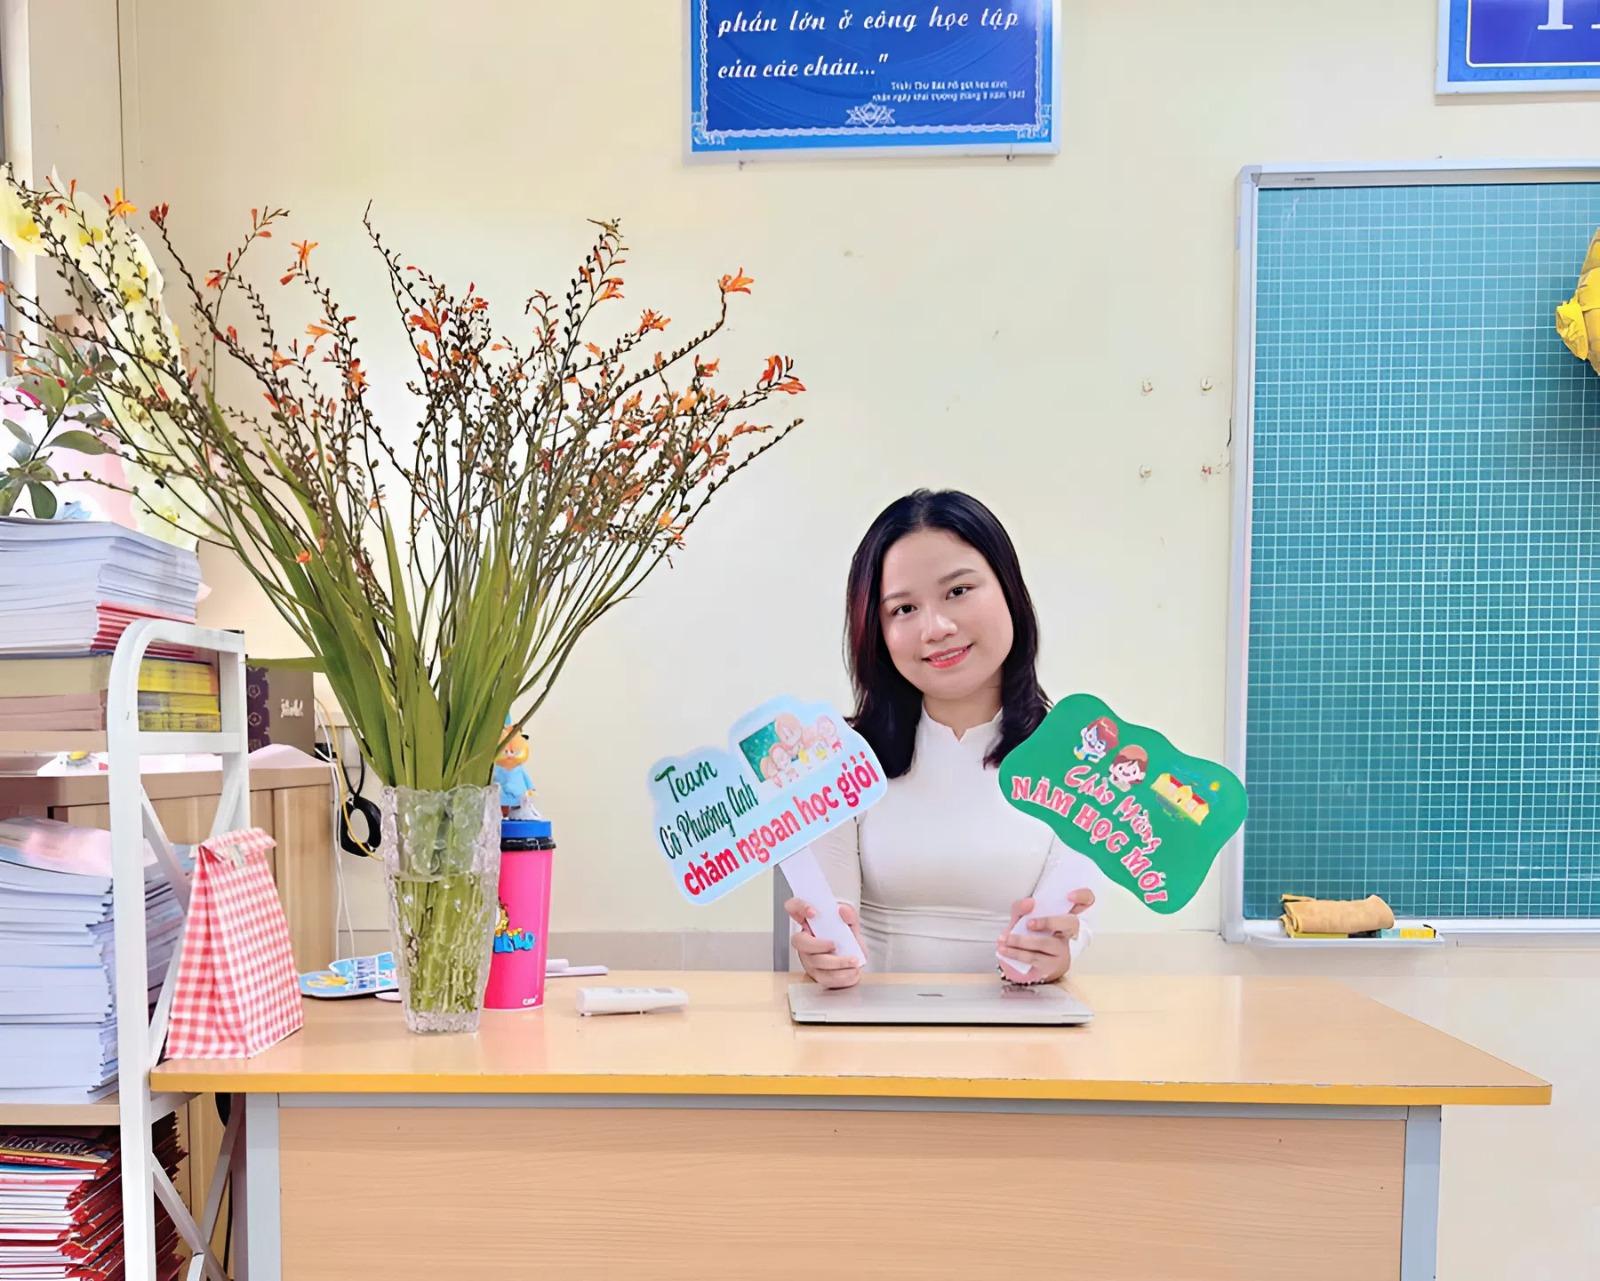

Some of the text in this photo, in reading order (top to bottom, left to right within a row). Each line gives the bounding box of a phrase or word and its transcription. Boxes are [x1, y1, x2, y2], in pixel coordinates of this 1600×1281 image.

[863, 10, 918, 32] công
[929, 6, 969, 31] học
[981, 8, 1019, 31] tập
[763, 59, 799, 78] các
[654, 761, 718, 803] Team
[683, 751, 880, 896] chăm ngoan học giỏi
[1011, 776, 1168, 903] NĂM HỌC MỚI
